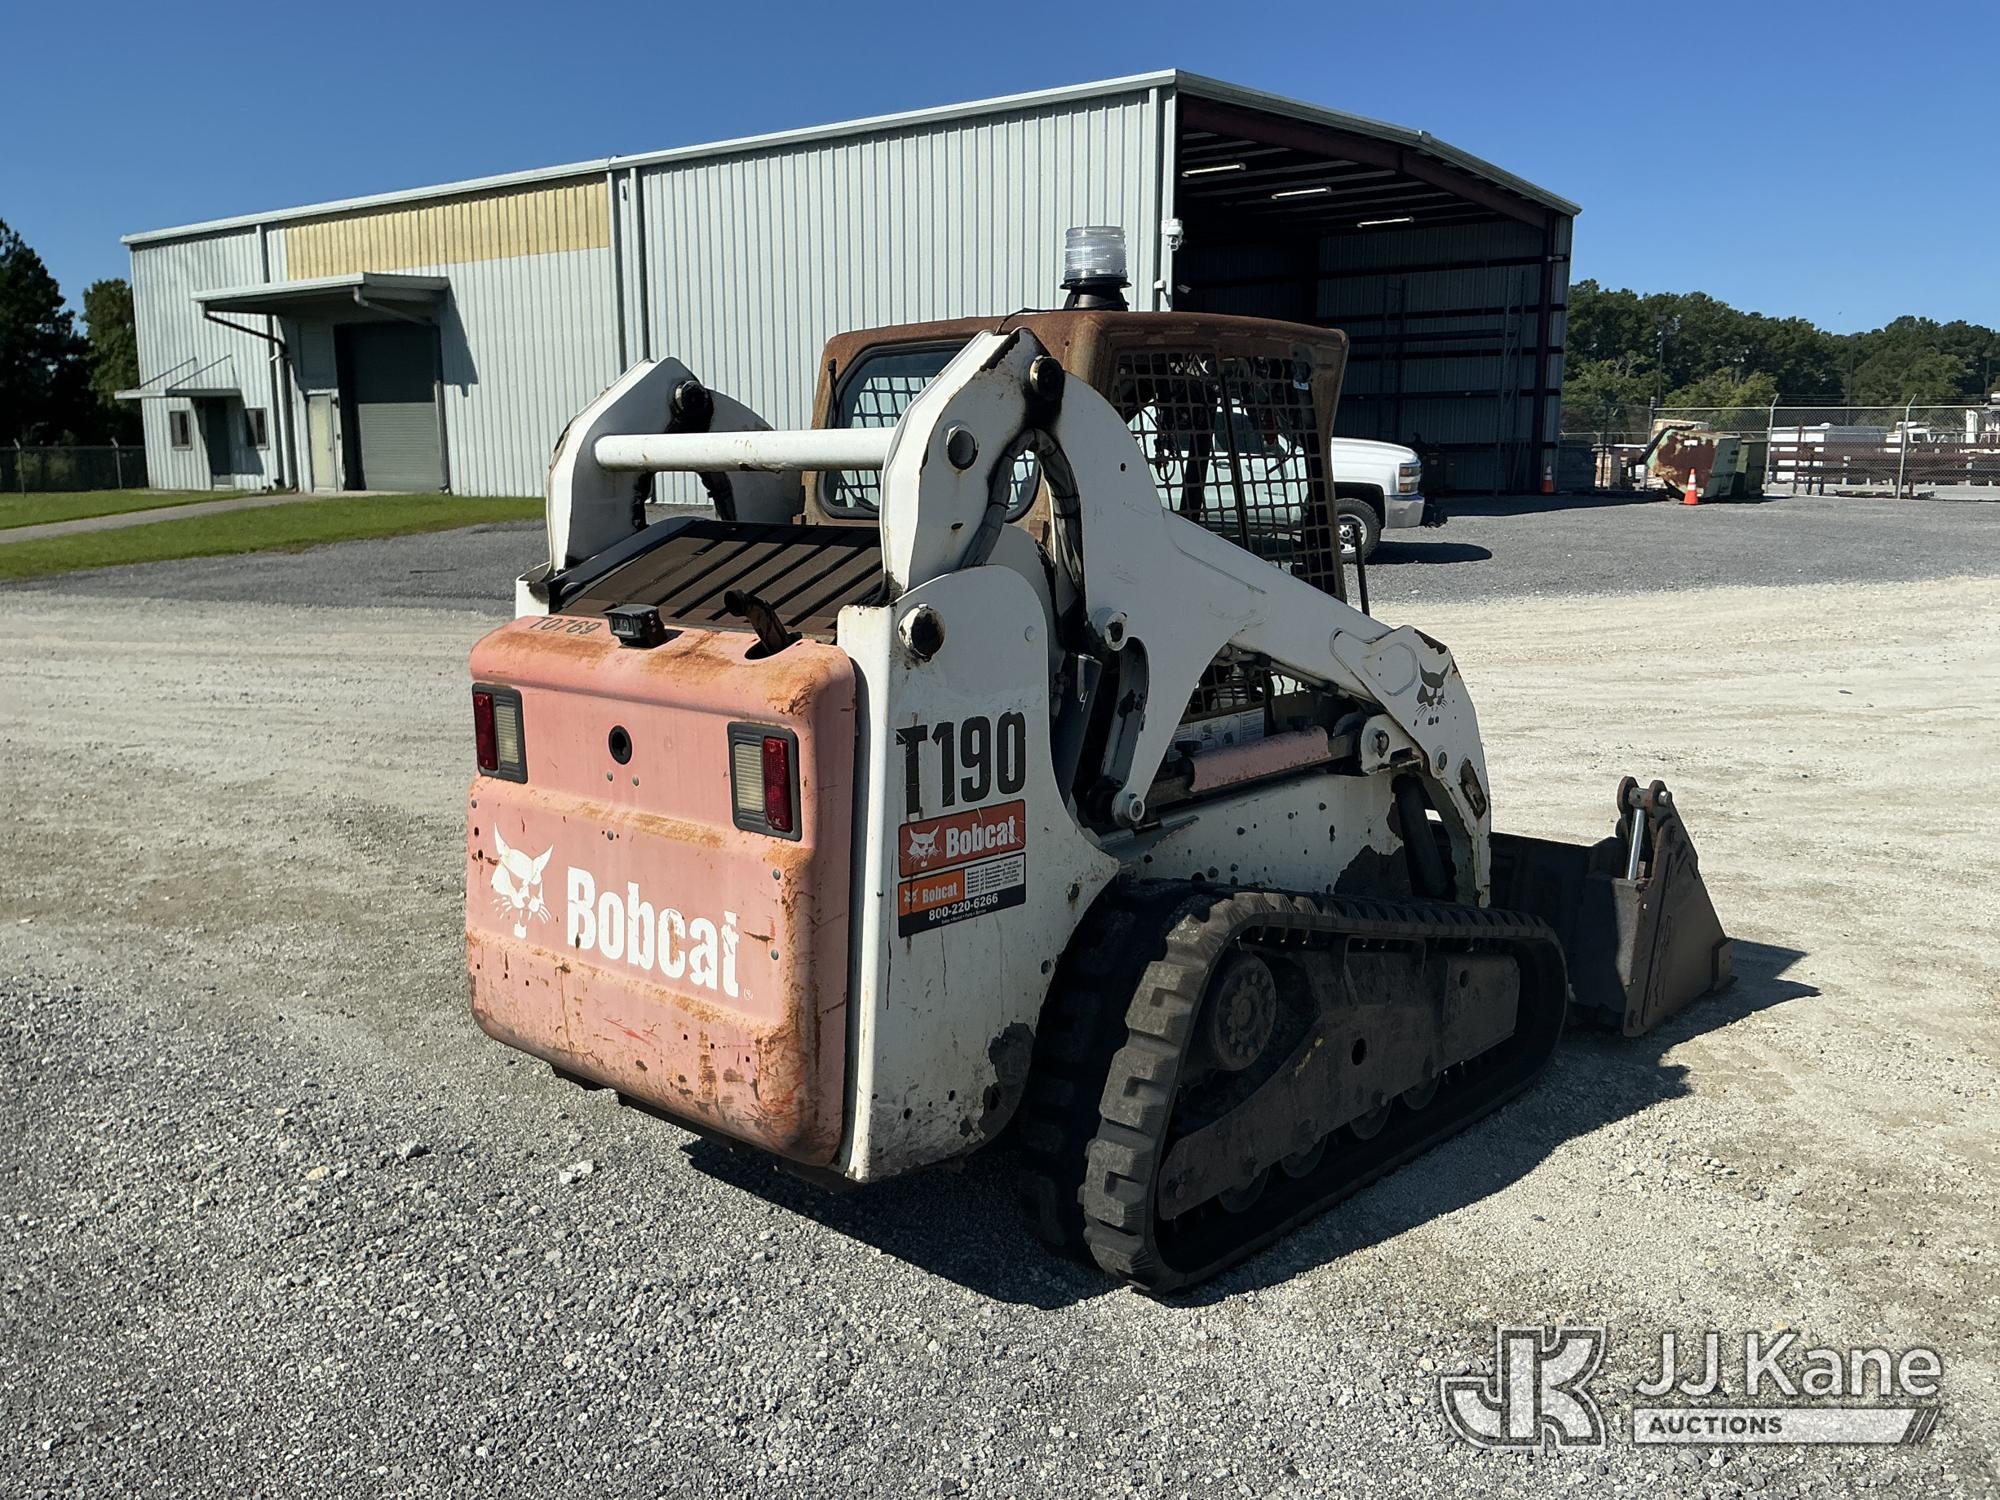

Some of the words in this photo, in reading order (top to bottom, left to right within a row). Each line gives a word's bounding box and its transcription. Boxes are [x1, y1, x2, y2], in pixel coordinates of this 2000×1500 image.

[896, 711, 1026, 815] T190
[945, 815, 1016, 859] Bobcat
[922, 882, 958, 904] Bobcat
[928, 893, 999, 921] 800-220-6266
[567, 866, 740, 998] Bobcat
